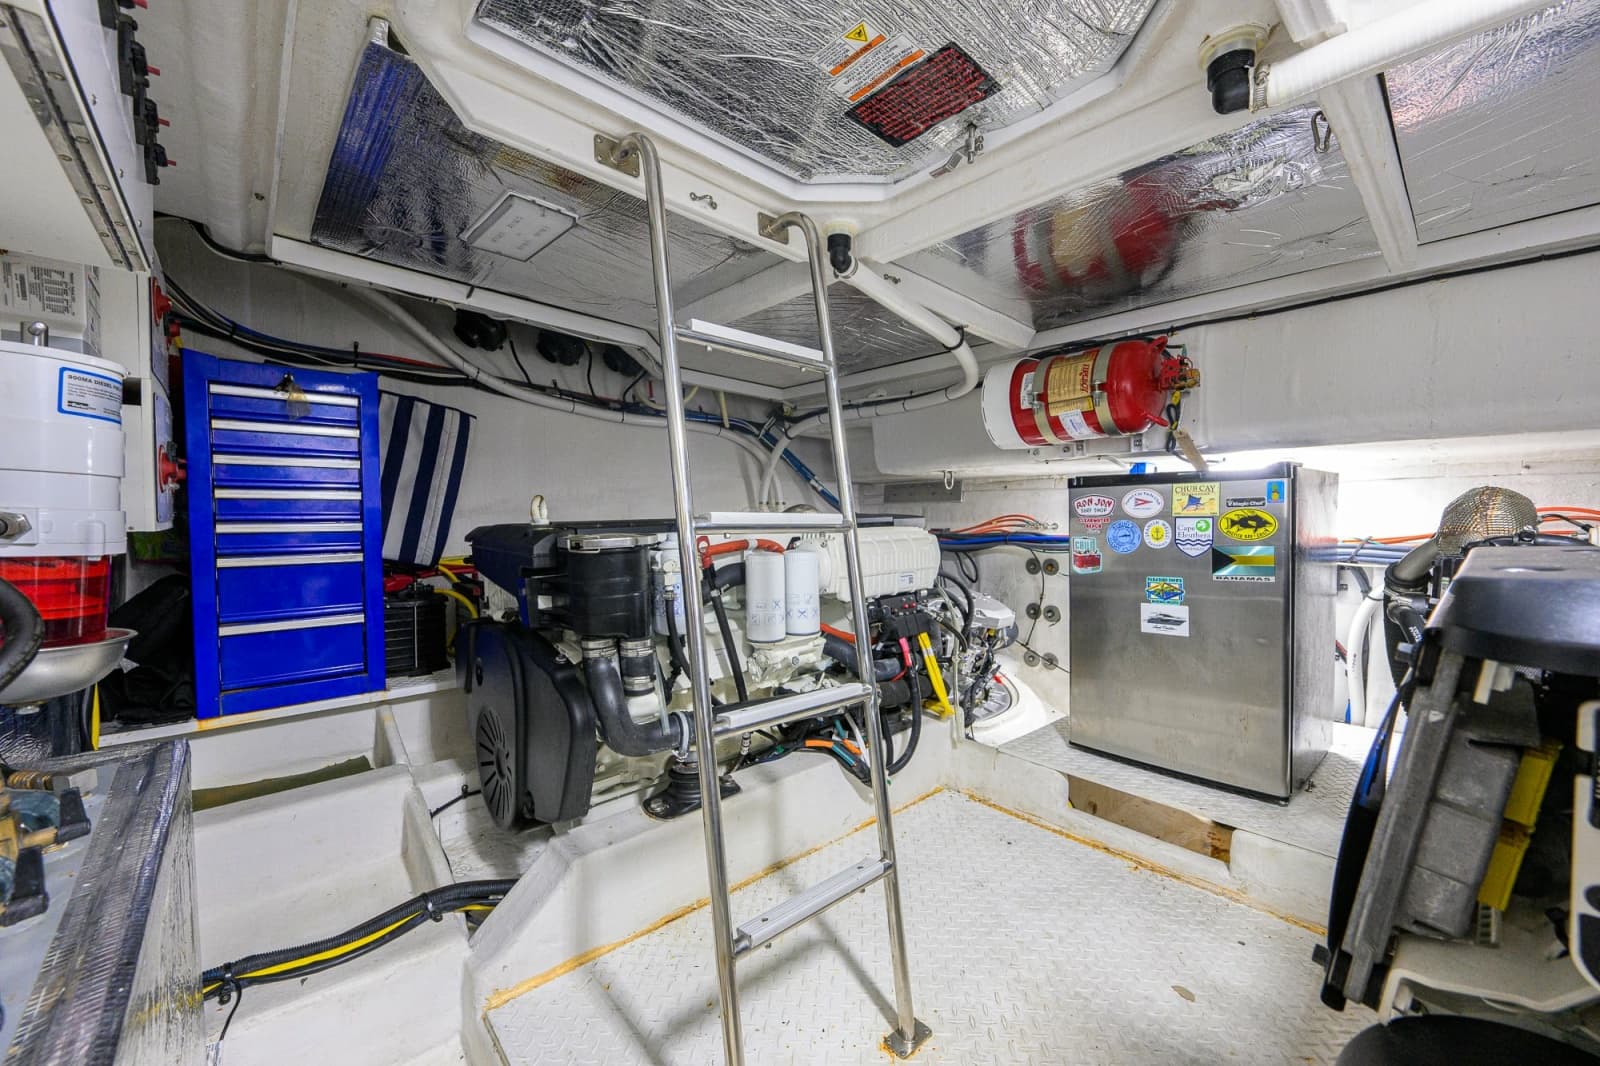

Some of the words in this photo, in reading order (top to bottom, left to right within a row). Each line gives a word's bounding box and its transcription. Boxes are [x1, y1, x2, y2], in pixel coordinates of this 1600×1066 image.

[1199, 484, 1216, 493] CAY
[1076, 498, 1093, 510] RON
[1095, 498, 1113, 508] JON
